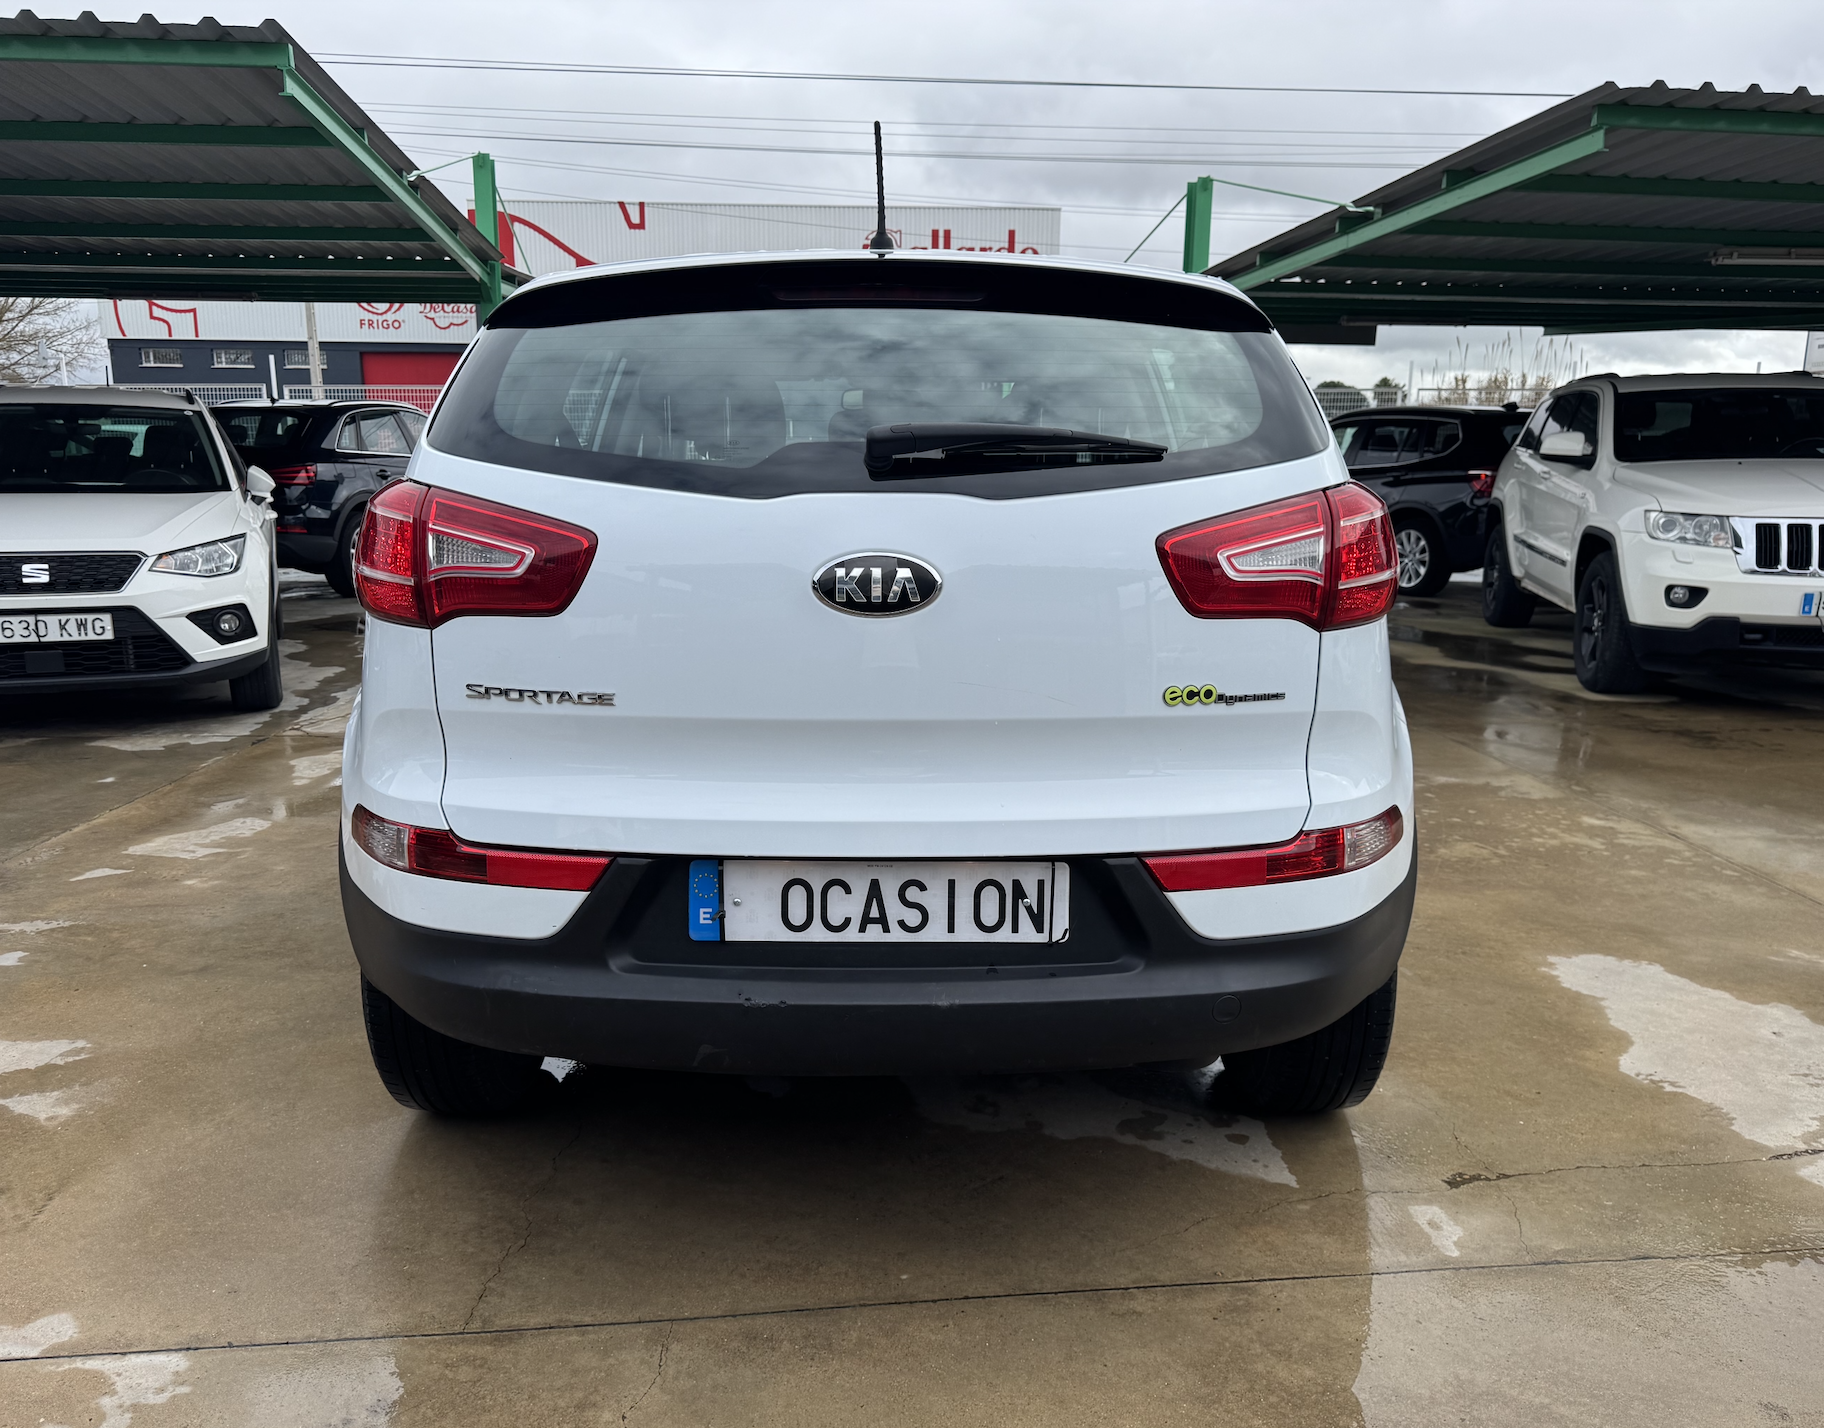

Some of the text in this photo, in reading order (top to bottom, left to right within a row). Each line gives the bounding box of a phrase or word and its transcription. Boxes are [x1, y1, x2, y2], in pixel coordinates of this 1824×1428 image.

[359, 319, 402, 330] FRIGO
[834, 567, 921, 602] KIA
[58, 617, 106, 638] KWG
[465, 683, 617, 706] SPORTAGE
[699, 877, 1046, 934] E OCASION
